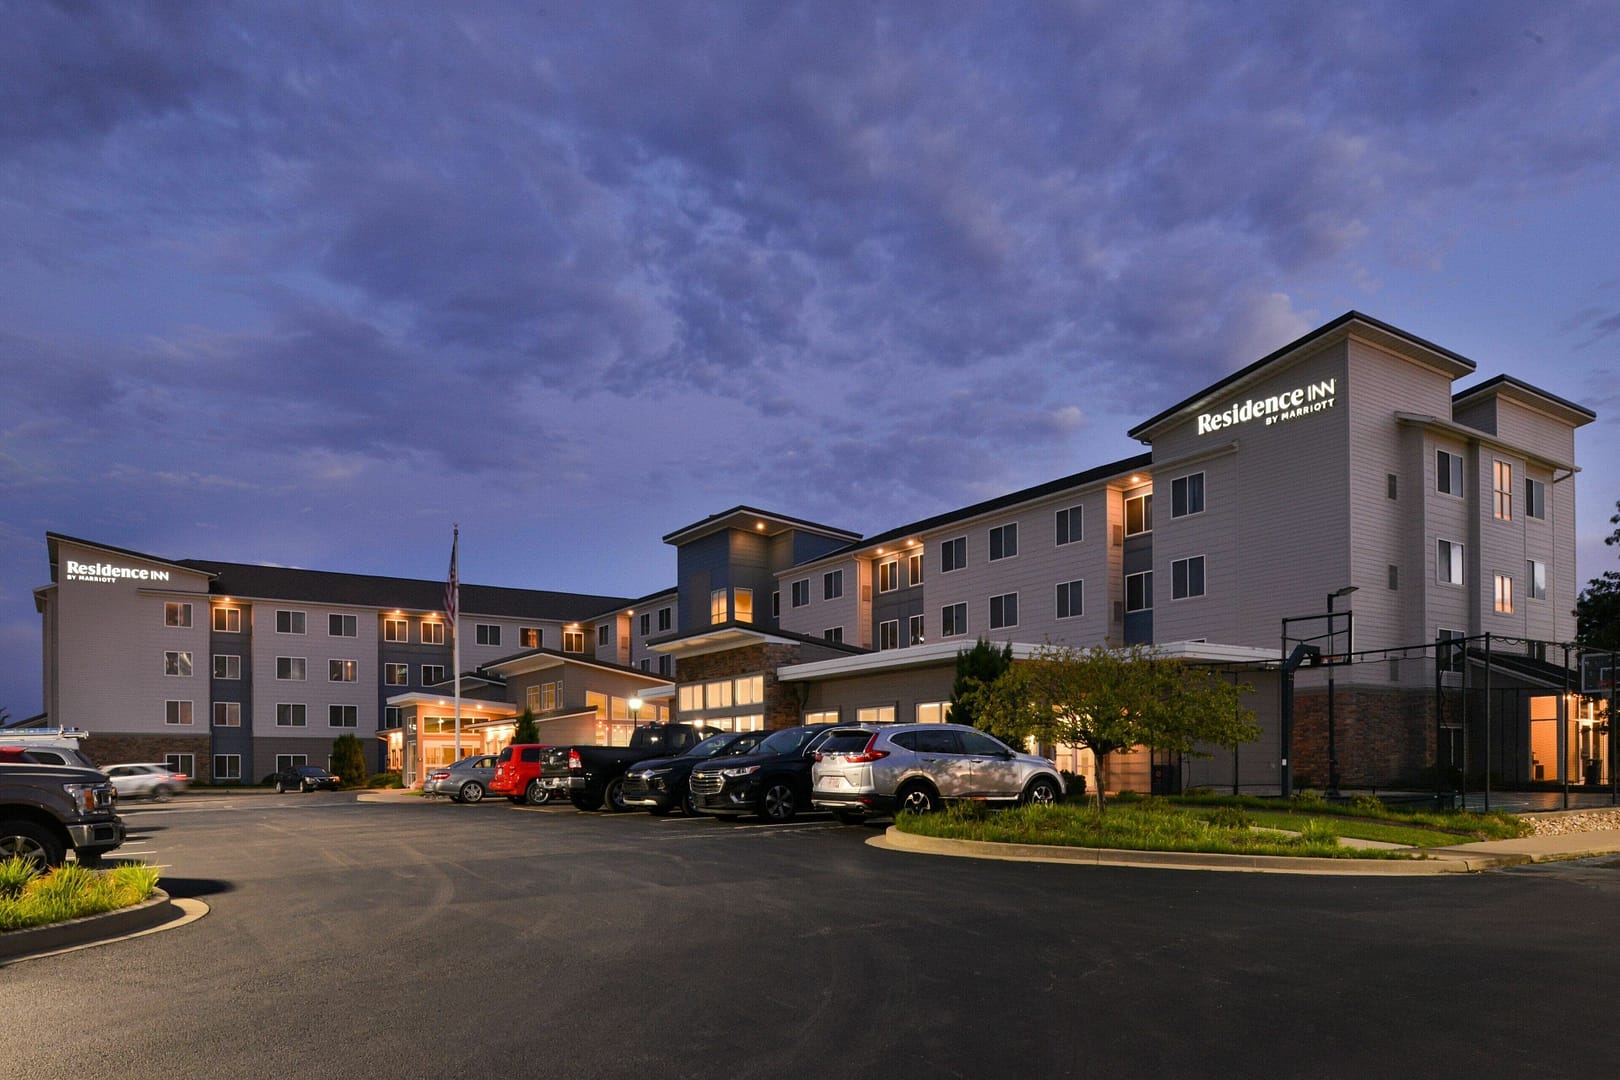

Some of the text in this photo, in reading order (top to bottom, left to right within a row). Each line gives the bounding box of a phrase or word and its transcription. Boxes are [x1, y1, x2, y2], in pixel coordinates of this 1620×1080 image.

[1197, 378, 1335, 435] Residence INN
[1265, 398, 1335, 426] BY MARRIOTT
[67, 561, 169, 581] Residence INN
[79, 575, 117, 583] MARRIOTT
